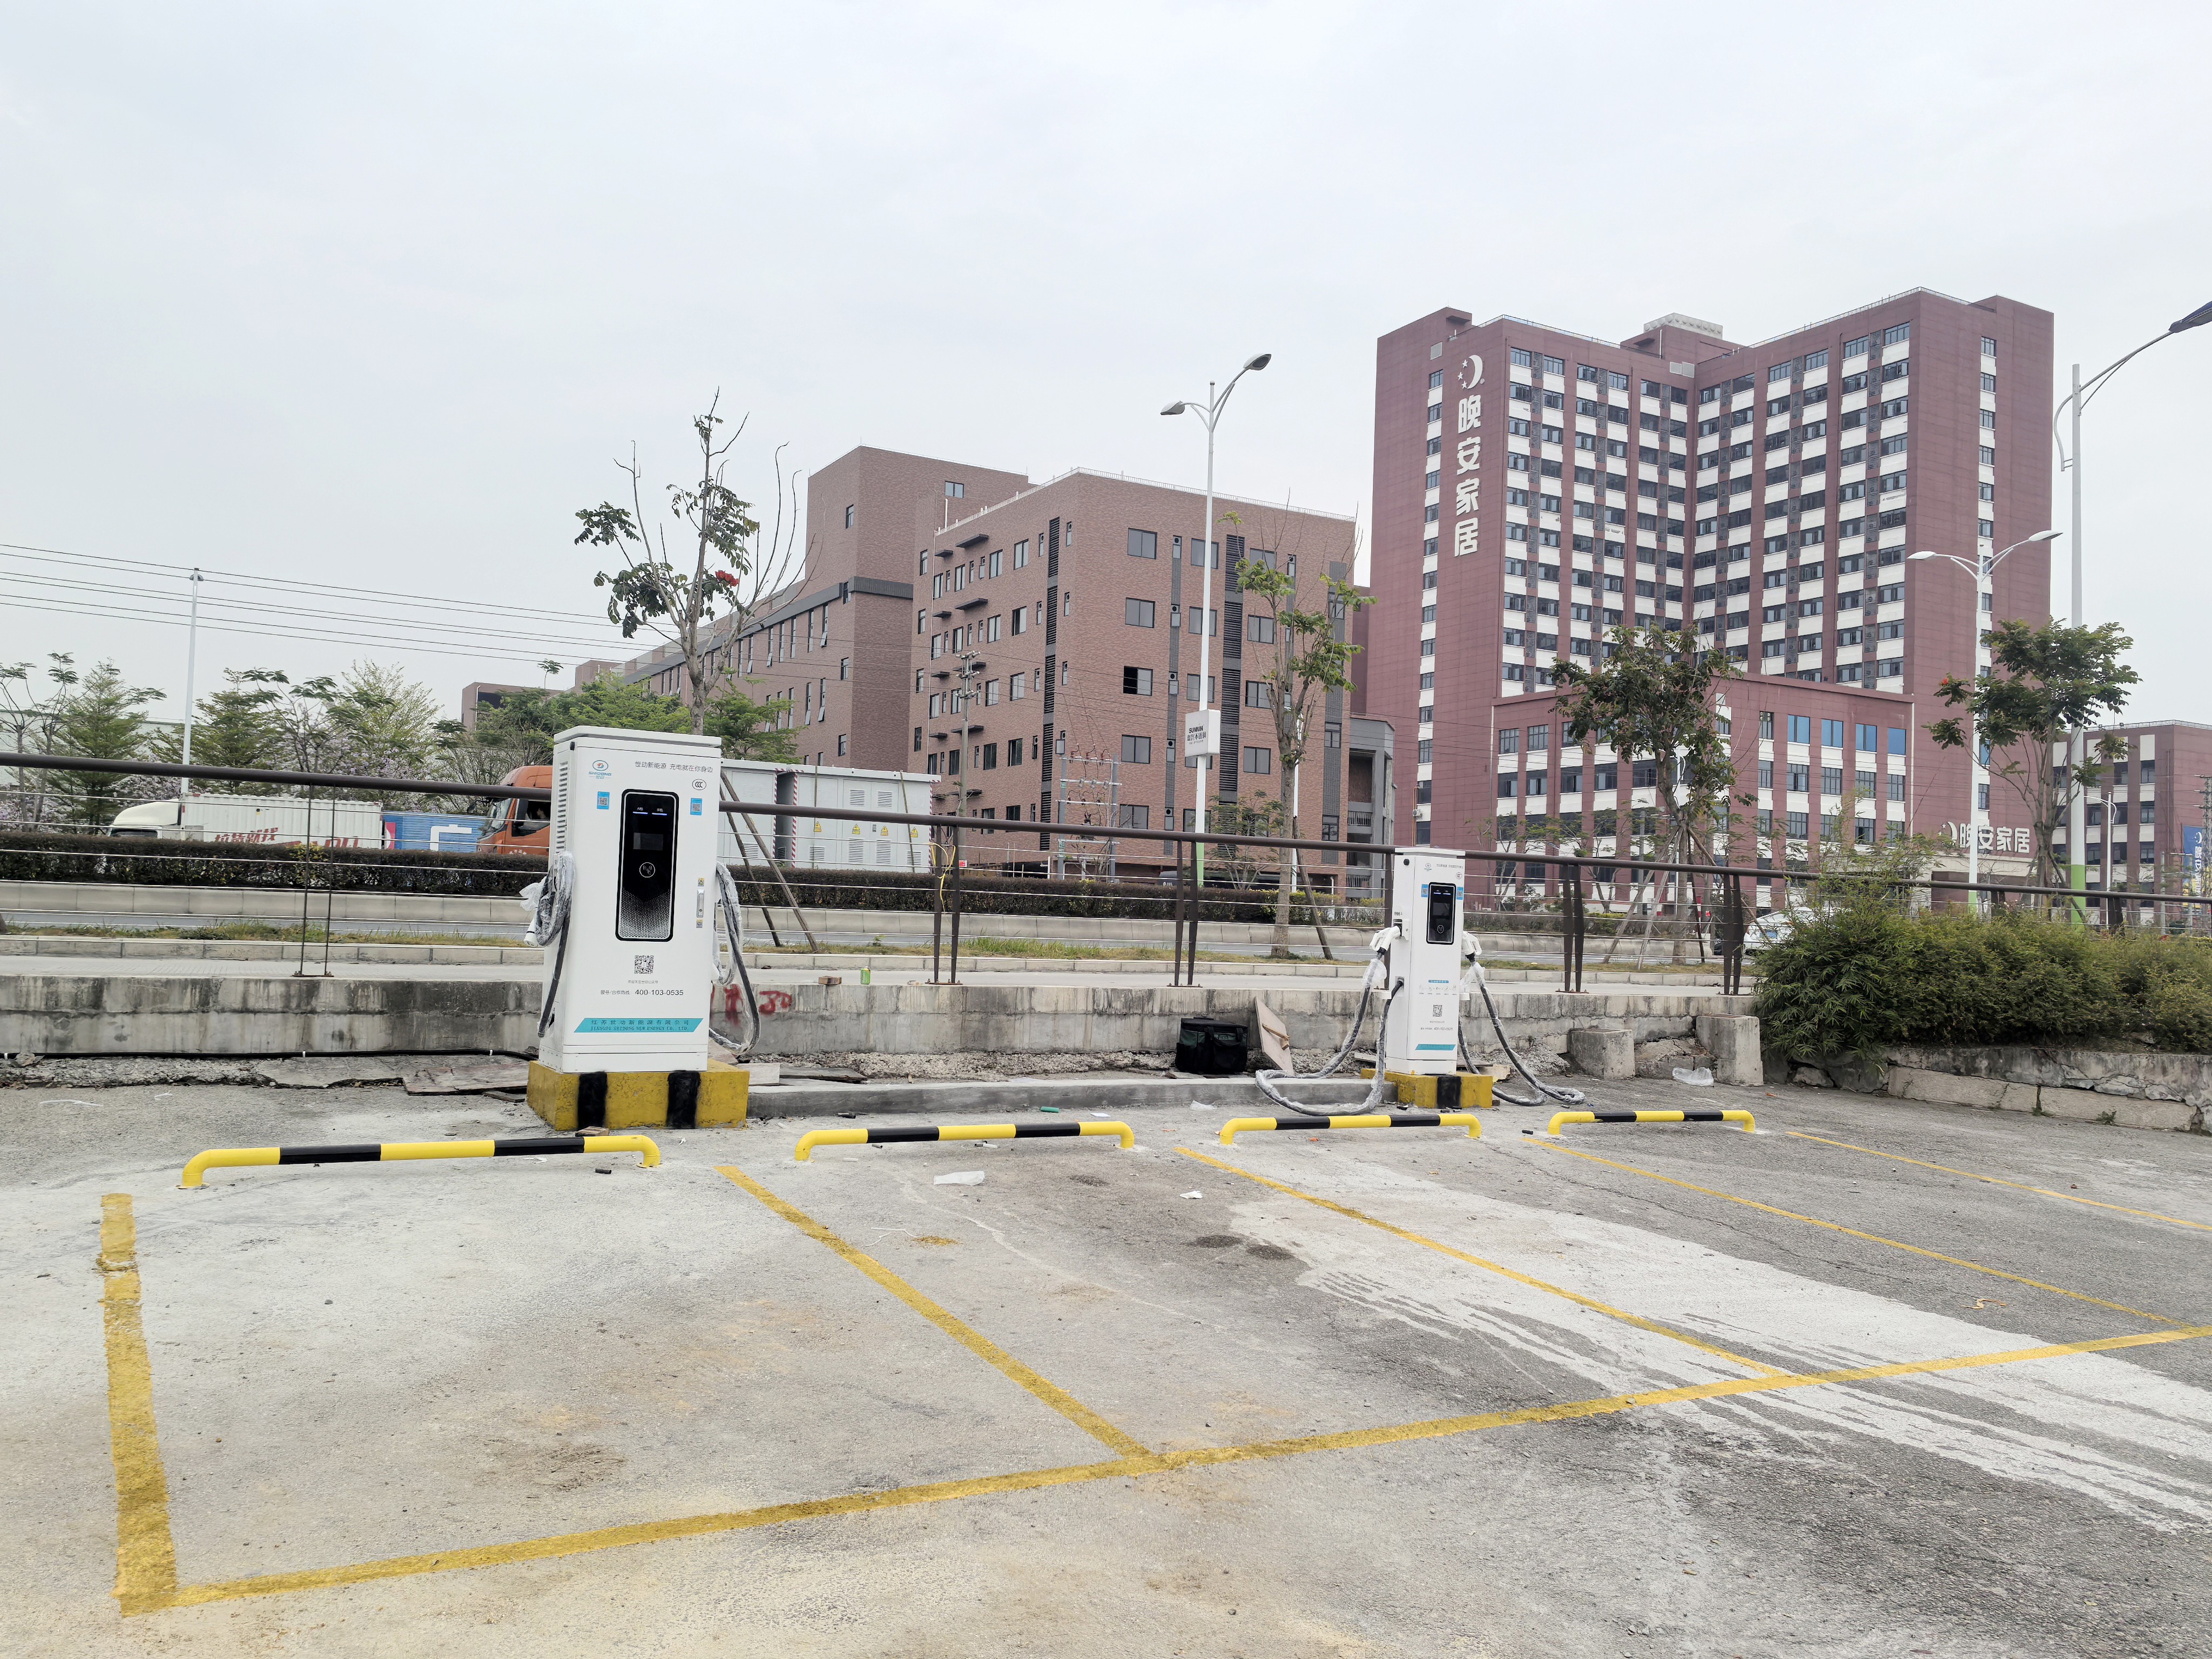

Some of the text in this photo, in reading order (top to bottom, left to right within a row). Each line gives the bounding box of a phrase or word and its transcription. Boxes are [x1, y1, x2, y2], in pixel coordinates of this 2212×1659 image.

[1454, 394, 1481, 557] 晚安家居
[635, 761, 713, 773] 世动新能源 充电就在你身边
